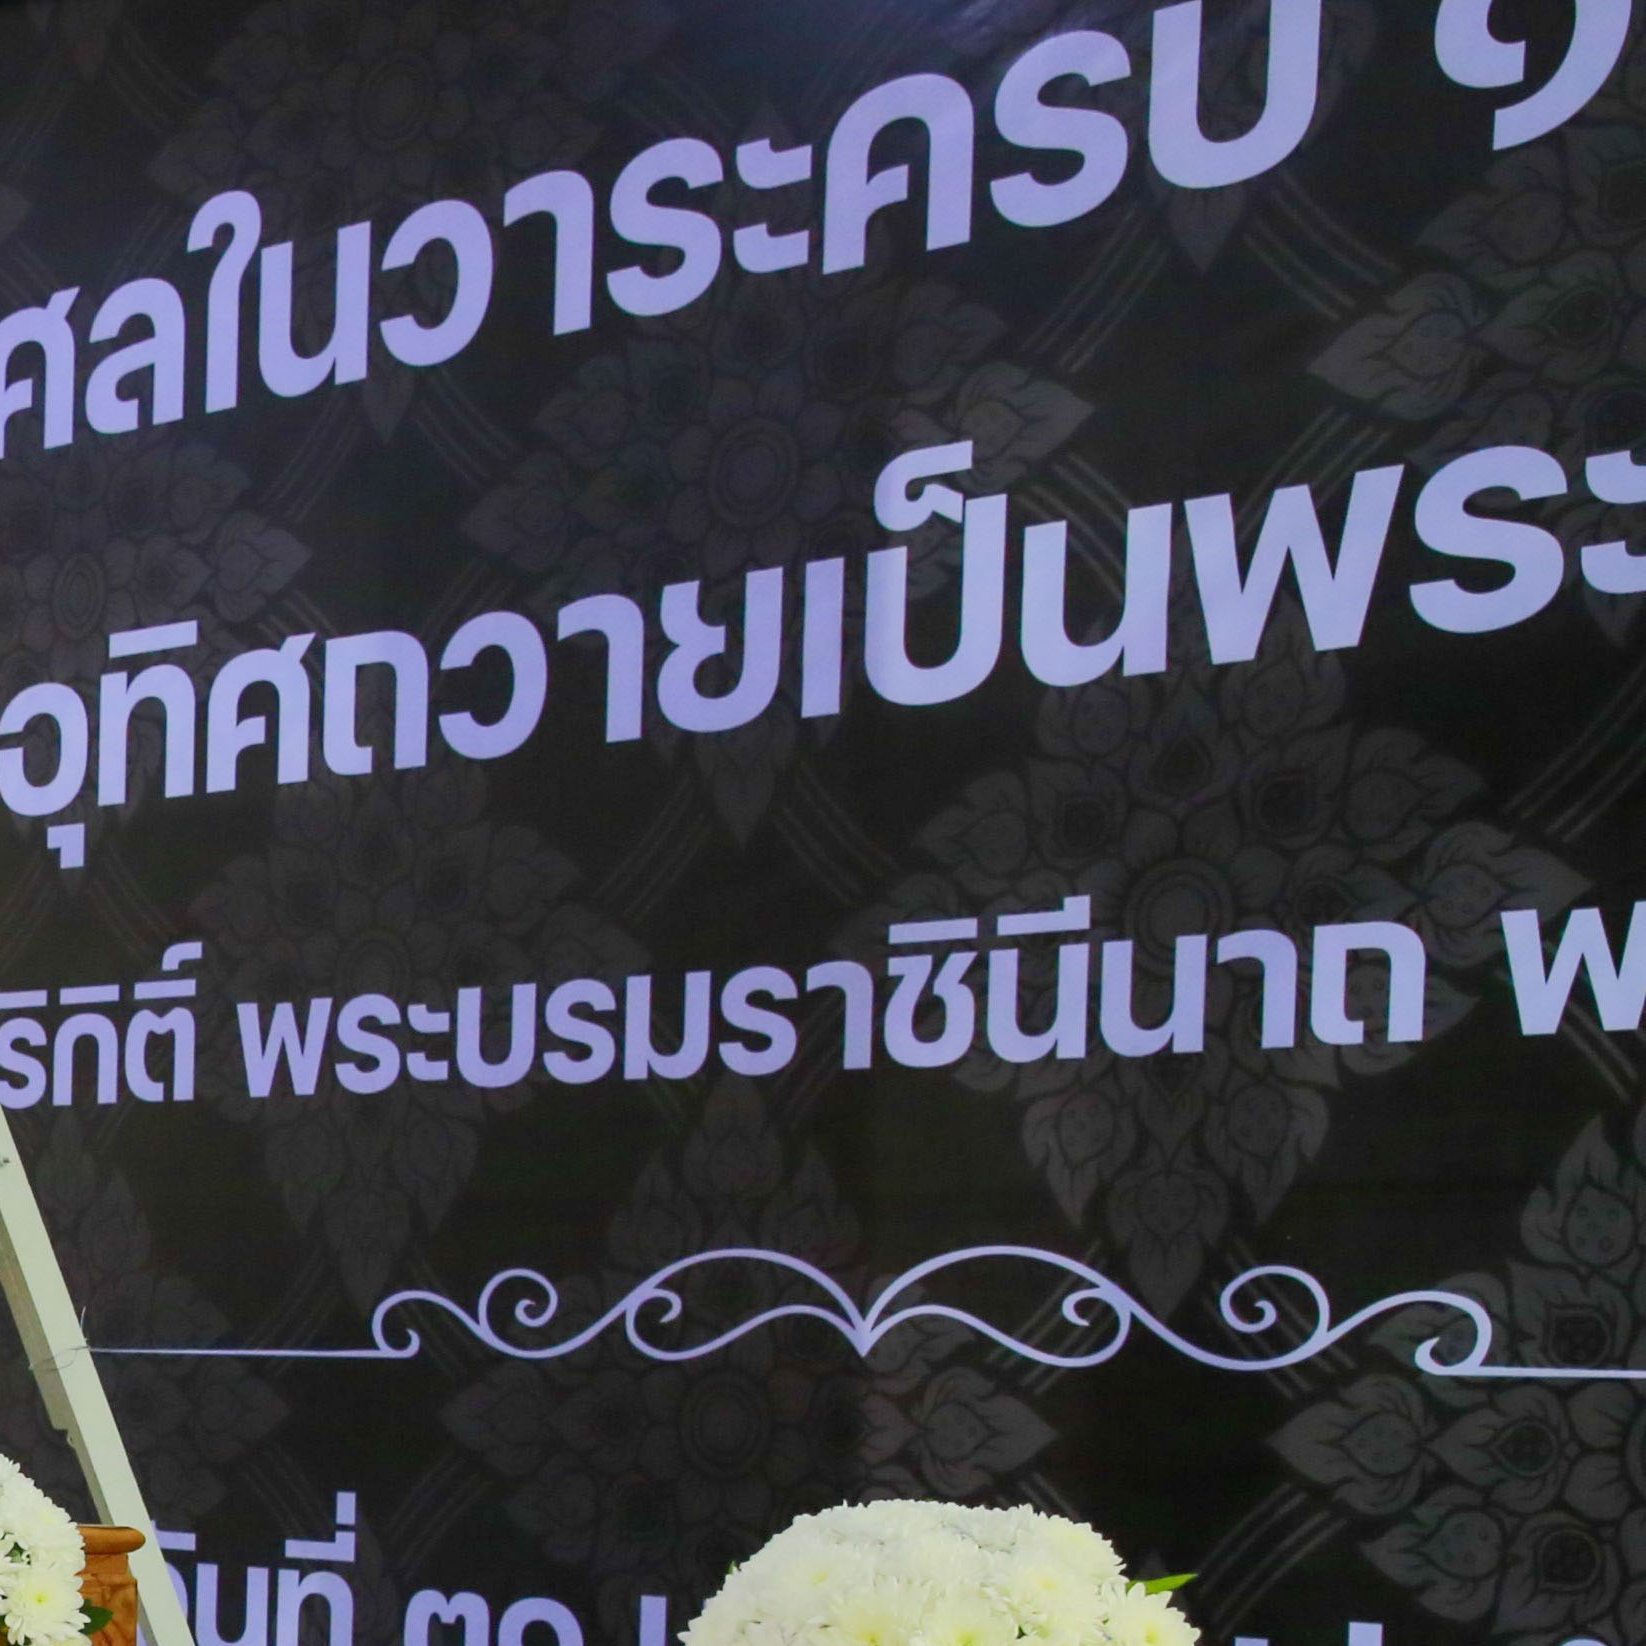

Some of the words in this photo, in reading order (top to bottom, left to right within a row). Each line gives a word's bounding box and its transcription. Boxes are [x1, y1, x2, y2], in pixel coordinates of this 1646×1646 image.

[236, 895, 1426, 1098] พระบรมราชินีนาถ
